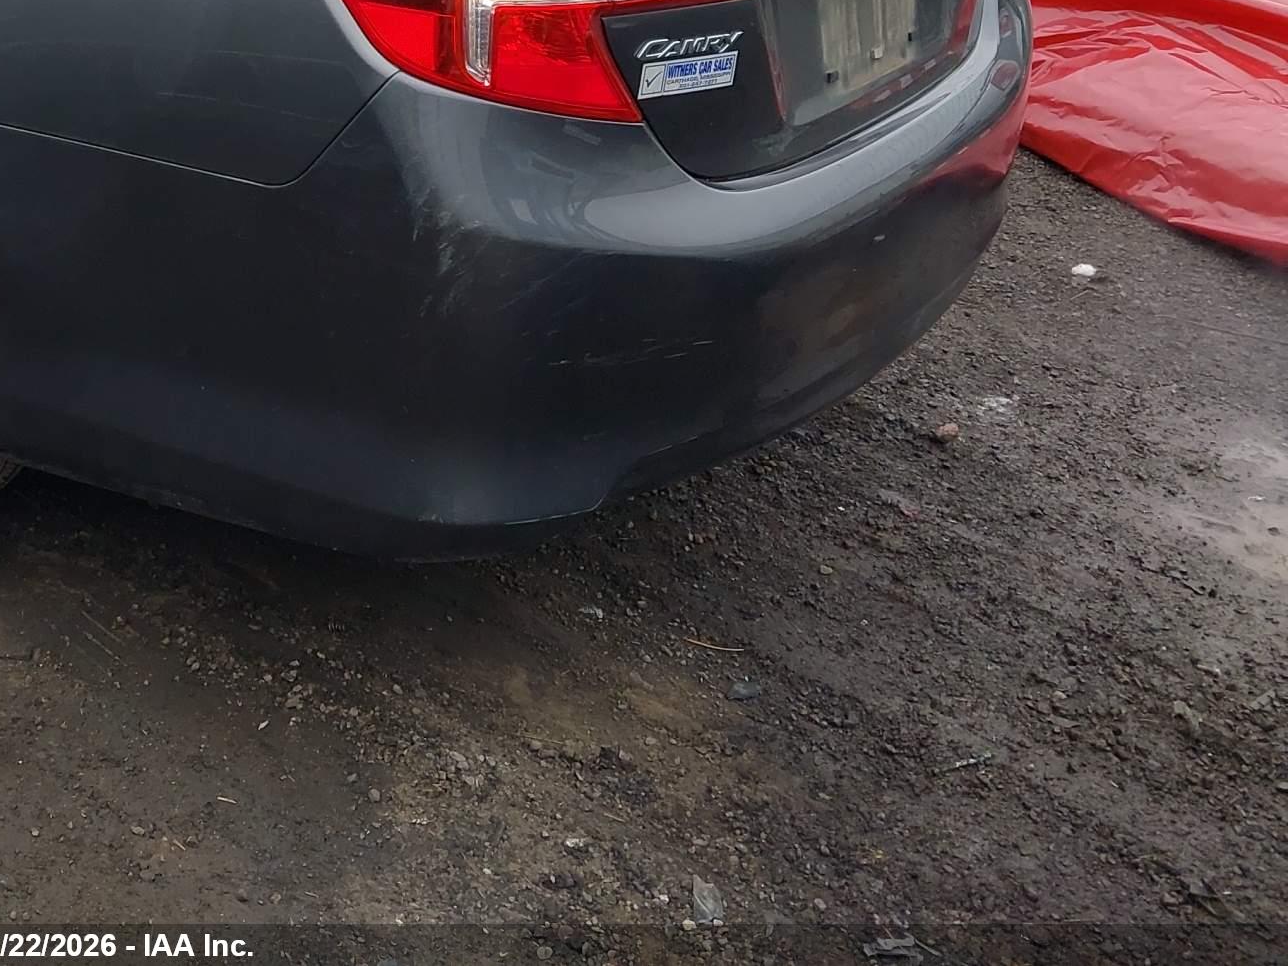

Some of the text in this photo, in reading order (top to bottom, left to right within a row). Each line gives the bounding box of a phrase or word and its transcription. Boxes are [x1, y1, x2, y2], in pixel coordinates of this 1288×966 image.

[634, 31, 744, 58] CAMRY
[667, 57, 734, 79] WITHERS CAR SALES
